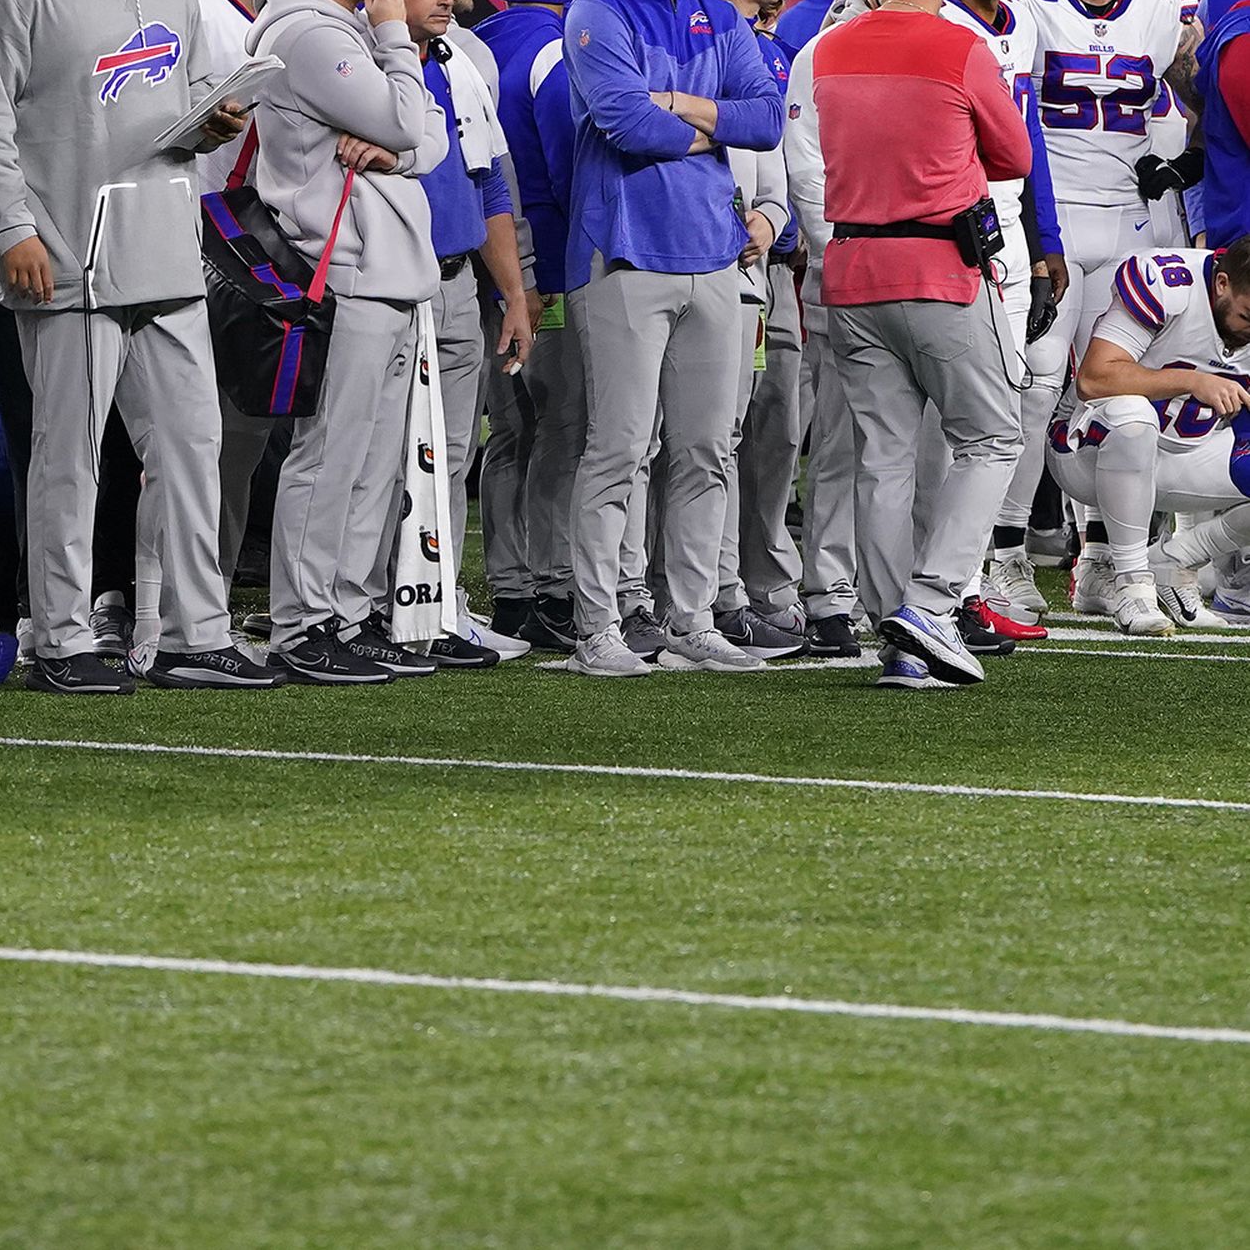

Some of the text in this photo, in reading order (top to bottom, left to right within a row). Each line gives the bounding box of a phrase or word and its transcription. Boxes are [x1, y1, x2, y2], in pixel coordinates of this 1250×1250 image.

[1088, 44, 1115, 54] BILLS
[1041, 51, 1157, 136] 52
[1152, 254, 1194, 287] 18
[1207, 359, 1236, 371] BILLS
